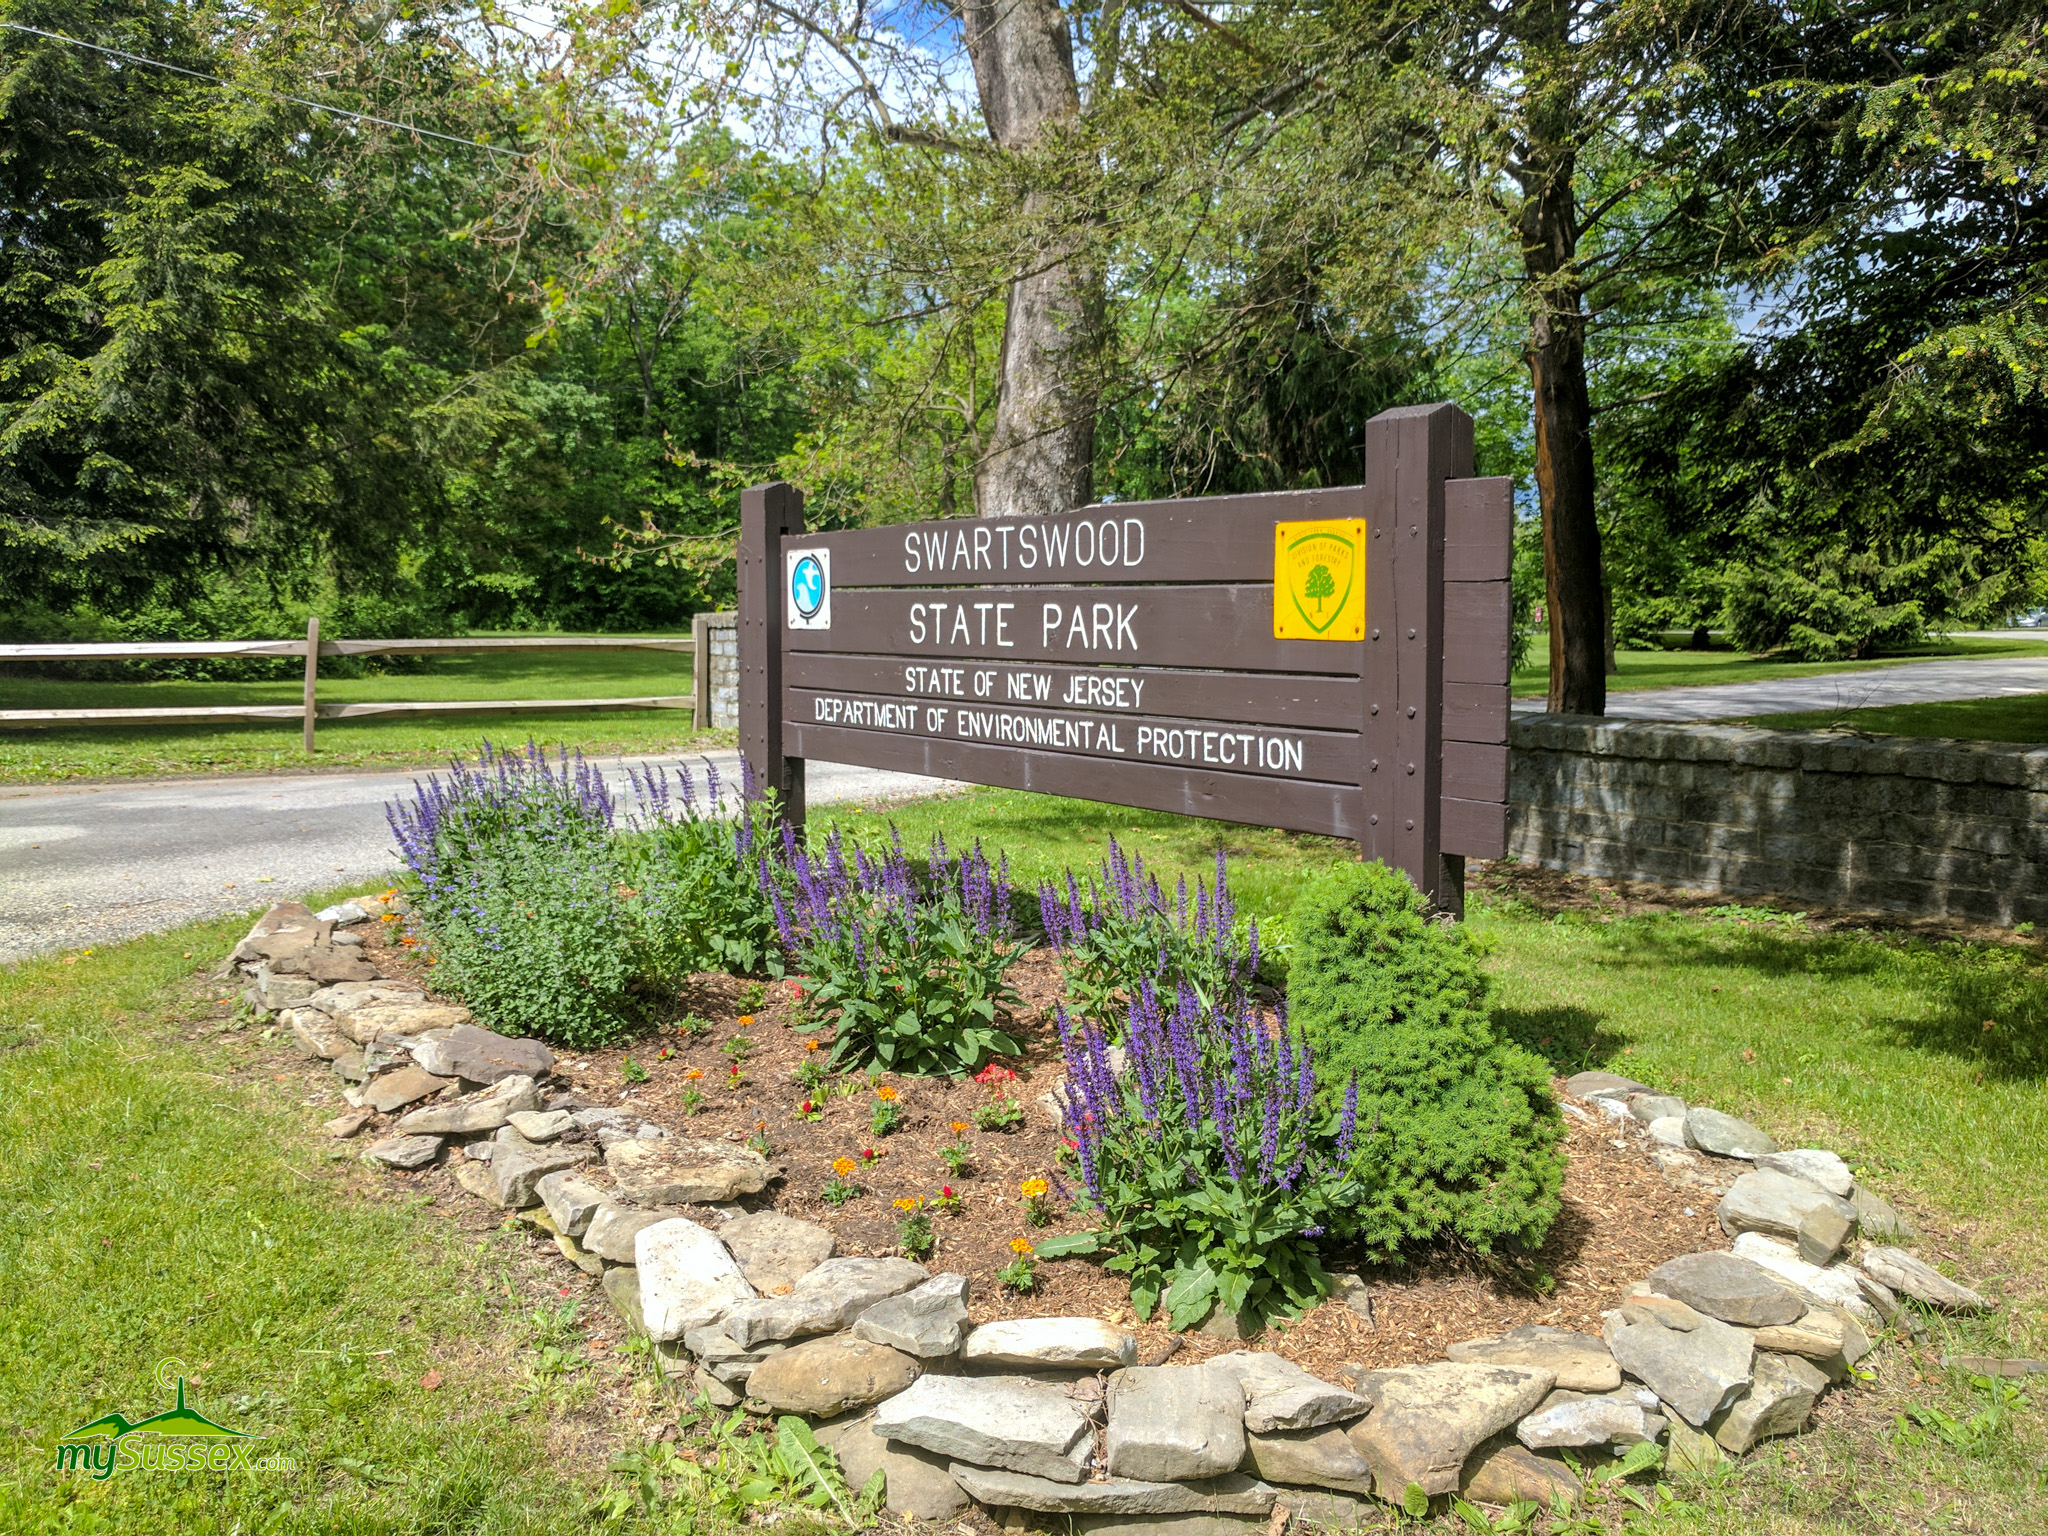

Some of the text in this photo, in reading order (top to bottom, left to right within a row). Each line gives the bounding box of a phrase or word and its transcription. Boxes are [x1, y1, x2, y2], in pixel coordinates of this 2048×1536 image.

[905, 519, 1145, 572] SWARTSWOOD
[1319, 542, 1327, 550] OF
[1329, 543, 1350, 559] PARKS
[909, 603, 1138, 650] STATE PARK
[905, 667, 1145, 708] STATE OF NEW JERSEY
[814, 698, 1303, 771] DEPARTMENT OF ENVIRONMENTAL PROTECTION
